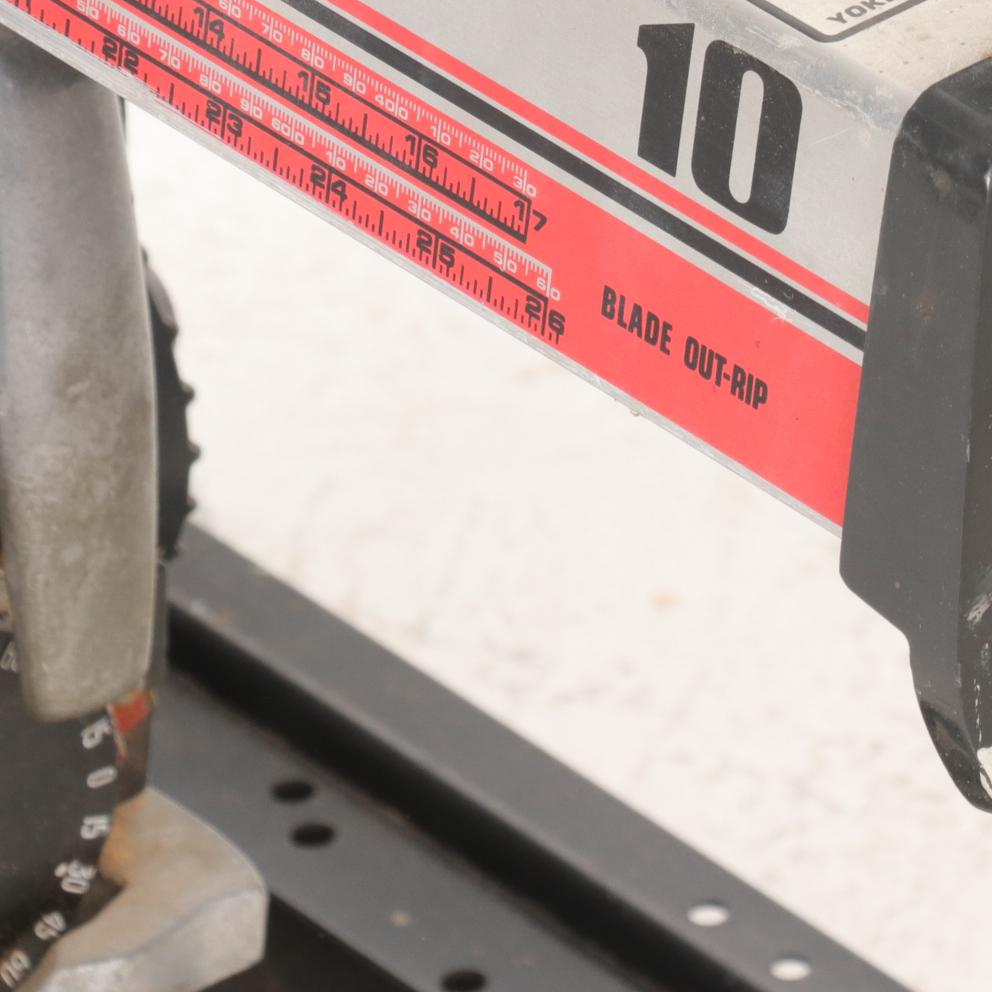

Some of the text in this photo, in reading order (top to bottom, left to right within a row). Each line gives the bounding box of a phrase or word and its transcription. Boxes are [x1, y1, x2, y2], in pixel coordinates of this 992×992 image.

[77, 0, 99, 20] 50
[117, 23, 141, 46] 60
[160, 49, 181, 70] 70
[199, 74, 222, 95] 80
[240, 98, 263, 119] 90
[271, 119, 304, 146] 600
[325, 149, 346, 171] 10
[364, 175, 389, 197] 20
[408, 200, 432, 222] 30
[449, 226, 475, 247] 40
[493, 251, 518, 274] 50
[536, 277, 561, 301] 60
[102, 38, 139, 74] 22
[206, 100, 243, 138] 23
[310, 165, 347, 201] 24
[416, 229, 456, 268] 25
[525, 295, 566, 335] 26
[195, 8, 224, 41] 14
[298, 70, 331, 105] 15
[404, 134, 439, 169] 16
[514, 199, 547, 231] 17
[261, 21, 284, 43] 70
[301, 47, 325, 69] 80
[343, 72, 367, 95] 90
[374, 94, 409, 121] 400
[429, 123, 452, 146] 10
[469, 150, 494, 173] 20
[513, 175, 537, 198] 30
[637, 23, 802, 235] 10
[601, 285, 768, 410] BLADE OUT-RIP
